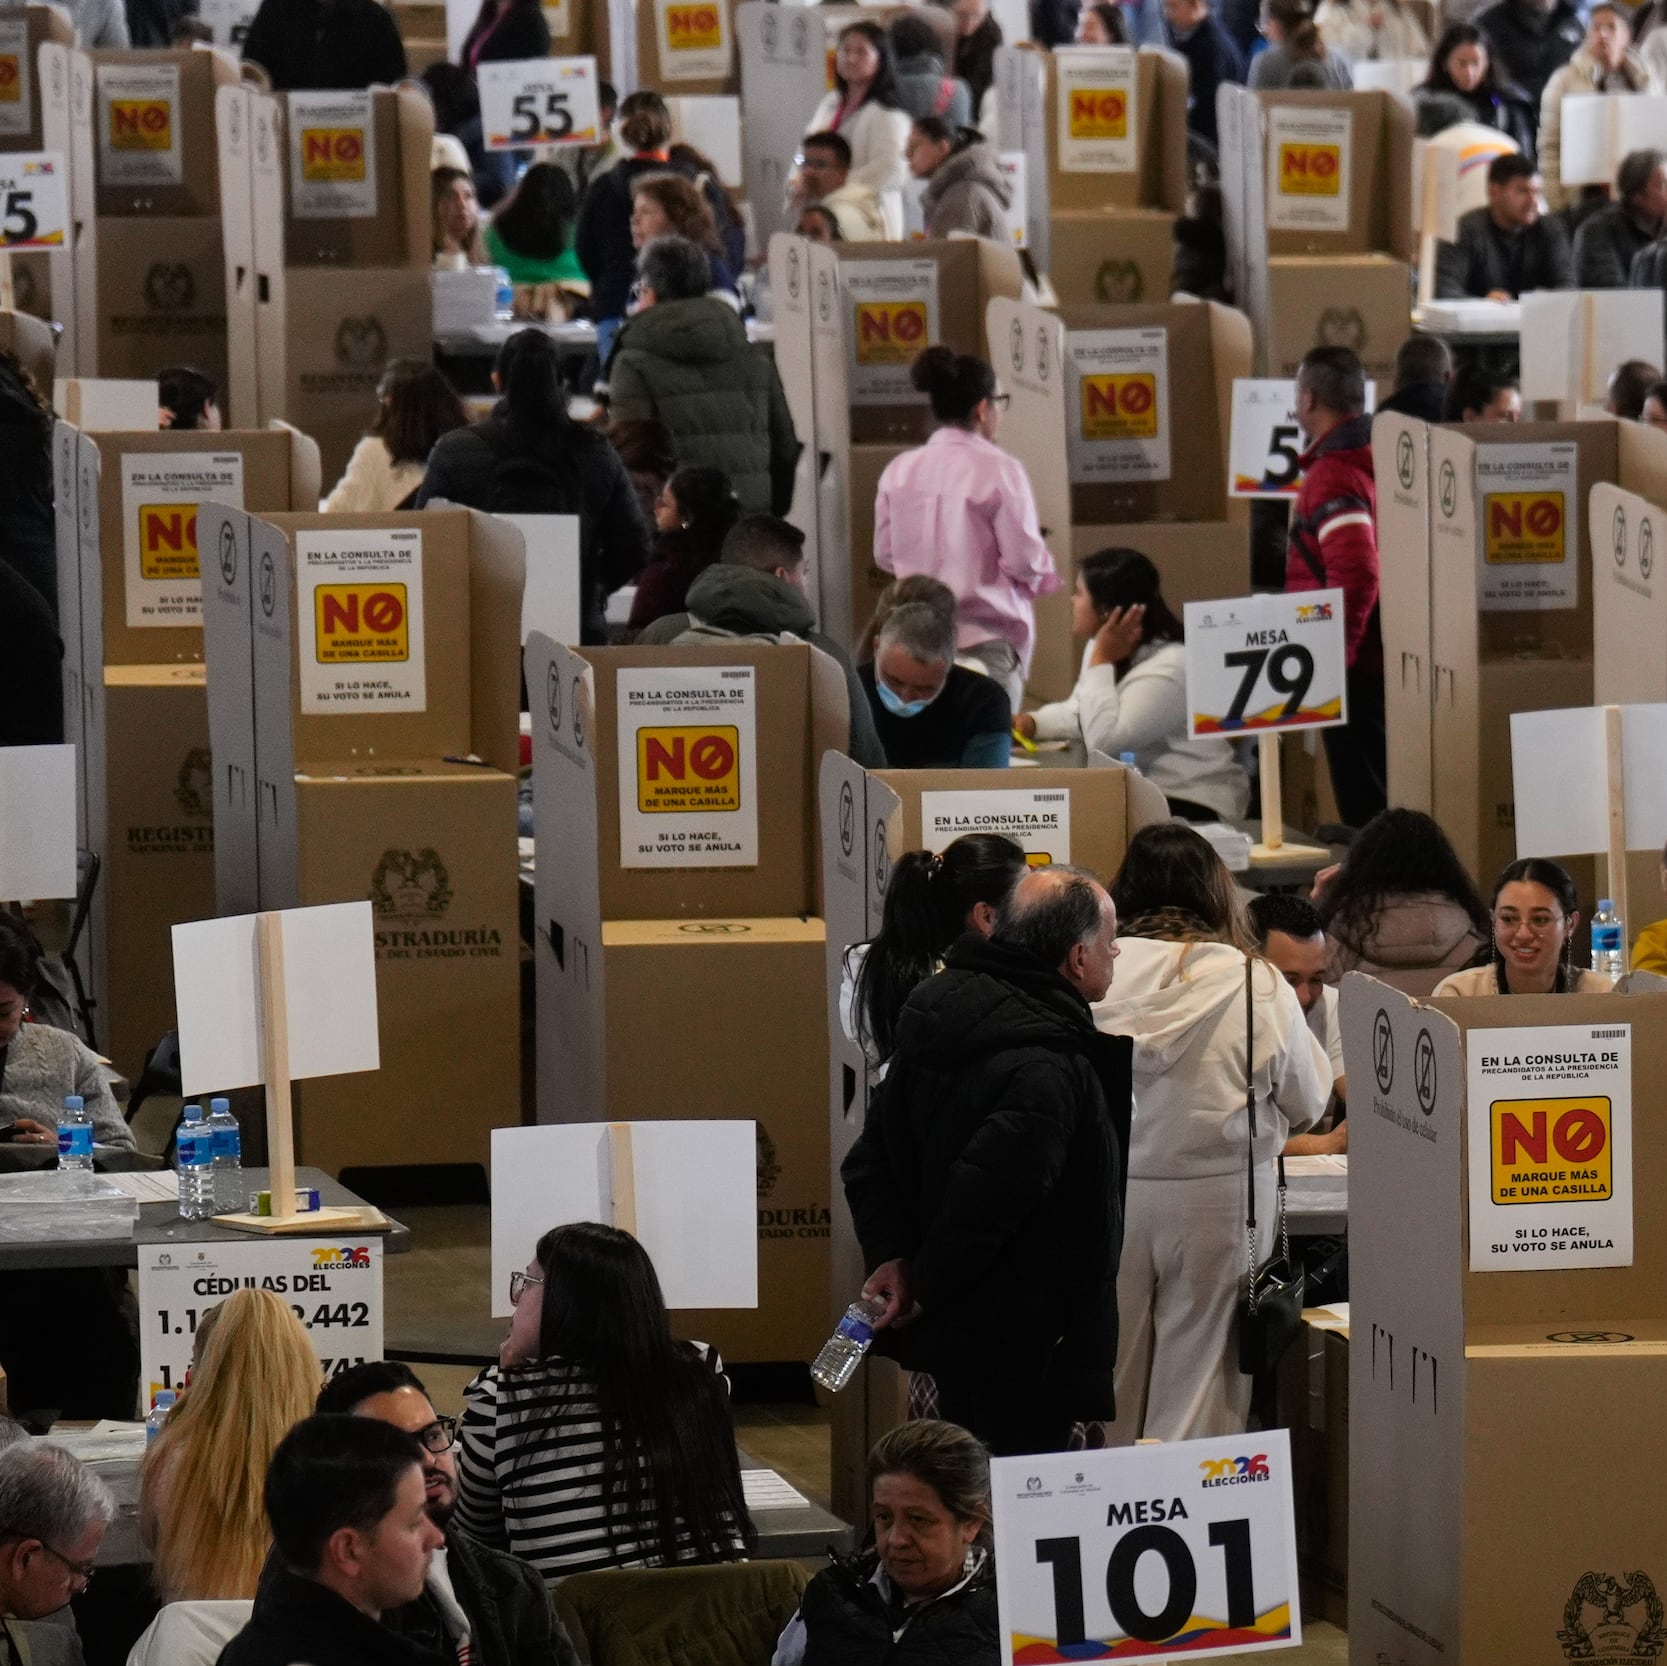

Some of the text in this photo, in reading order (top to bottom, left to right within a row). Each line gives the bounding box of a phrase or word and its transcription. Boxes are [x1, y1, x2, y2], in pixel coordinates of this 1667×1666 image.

[511, 93, 573, 139] 55
[304, 133, 362, 165] NO
[3, 191, 38, 243] 5
[860, 307, 926, 342] NO
[1086, 379, 1155, 416] NO
[1263, 426, 1306, 486] 5
[1489, 498, 1562, 537] NO
[322, 591, 403, 635] NO
[1246, 629, 1288, 646] MESA
[629, 691, 644, 699] EN
[648, 691, 662, 699] LA
[666, 690, 725, 699] CONSULTA
[1224, 644, 1314, 721] 79
[646, 736, 734, 781] NO
[1481, 1053, 1618, 1066] EN LA CONSULTA DE
[1482, 1066, 1546, 1074] PRECANDIDATOS
[1501, 1109, 1606, 1165] NO
[1511, 1169, 1598, 1182] MARQUE MÁS
[1500, 1184, 1606, 1196] DE UNA CASILLA
[1515, 1227, 1590, 1238] SI LO HACE,
[310, 1247, 370, 1264] 2026
[1492, 1240, 1613, 1252] SU VOTO SE ANULA
[313, 1262, 370, 1270] ELECCIONES
[294, 1275, 331, 1292] DEL
[1200, 1454, 1269, 1478] 2026
[1202, 1473, 1270, 1488] ELECCIONES
[1106, 1498, 1188, 1526] MESA
[1036, 1519, 1255, 1648] 101
